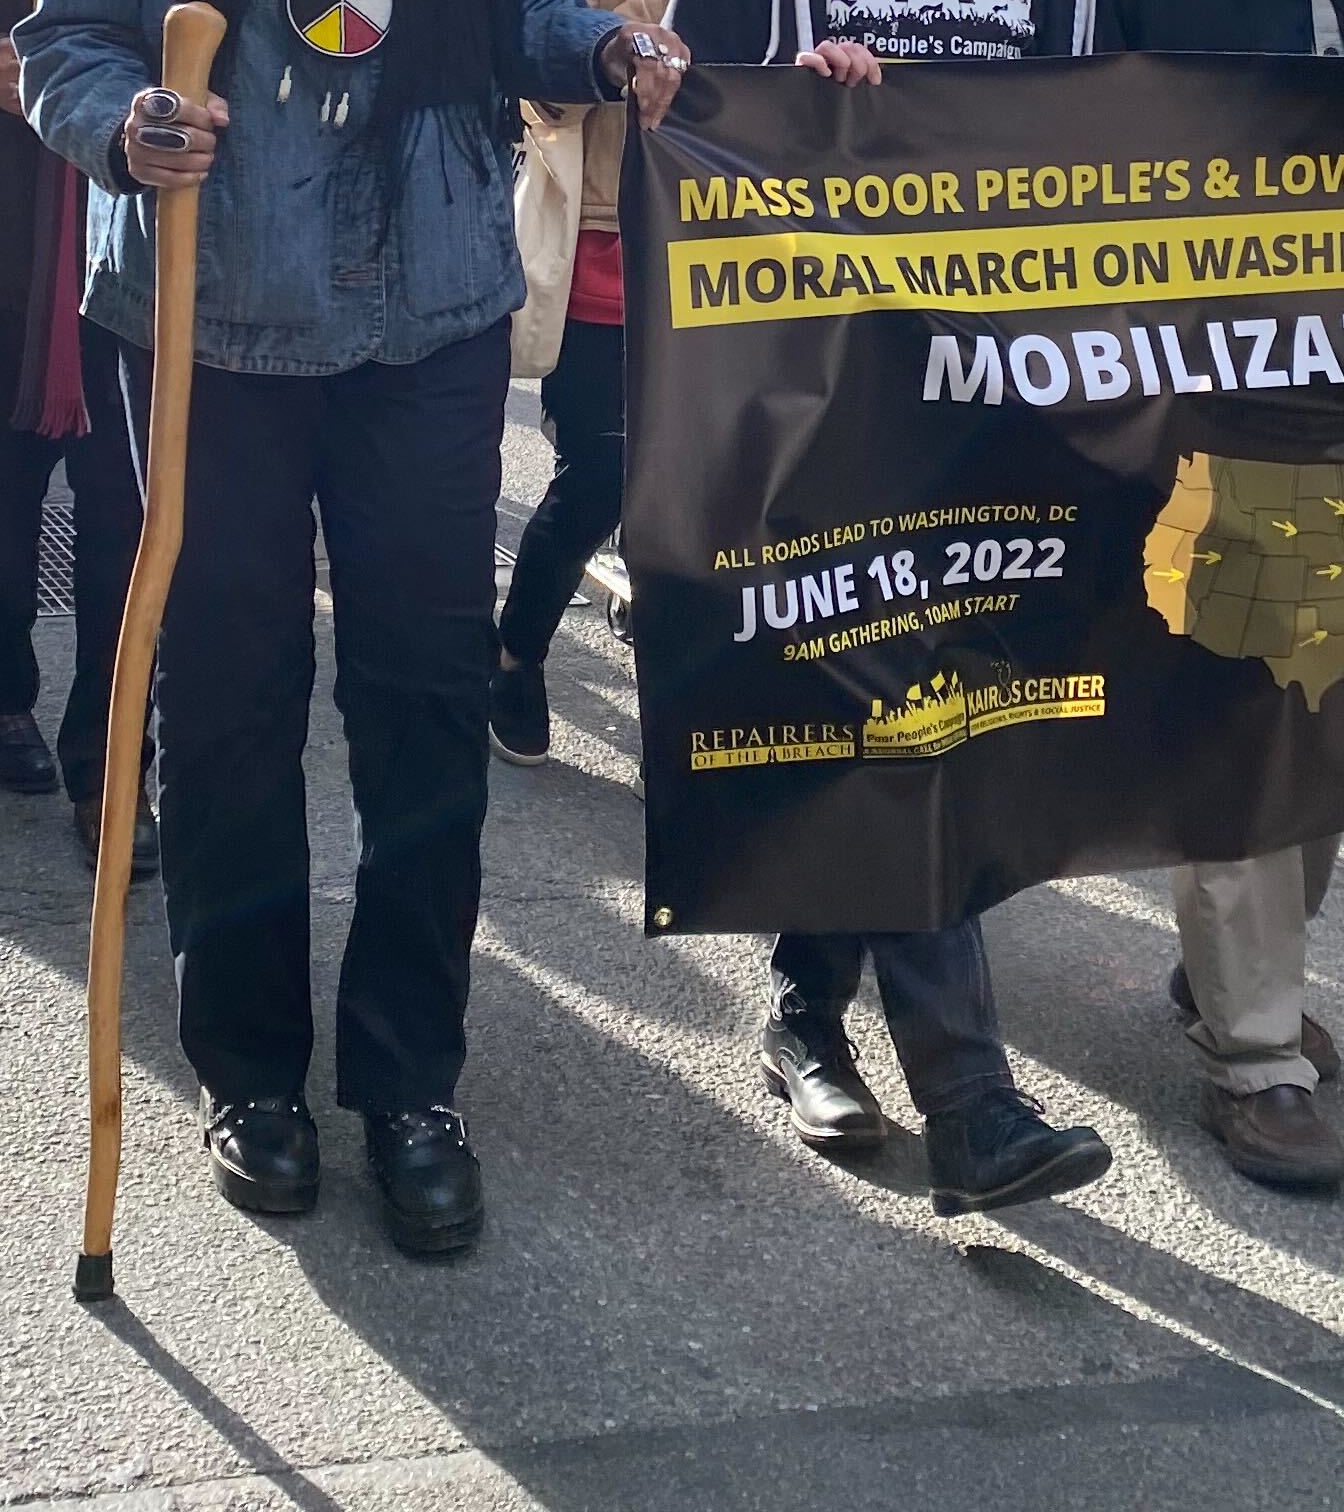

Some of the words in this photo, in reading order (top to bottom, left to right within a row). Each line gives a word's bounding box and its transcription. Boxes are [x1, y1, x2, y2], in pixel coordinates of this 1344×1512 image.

[863, 32, 944, 57] People's
[950, 35, 1022, 60] Campaign
[679, 176, 815, 222] MASS
[823, 172, 965, 219] POOR
[976, 159, 1191, 213] PEOPLE'S
[1202, 158, 1241, 200] &
[689, 253, 896, 310] MORAL
[896, 246, 1078, 297] MARCH
[1093, 240, 1169, 287] ON
[714, 548, 755, 571] ALL
[762, 533, 821, 564] ROADS
[823, 522, 866, 551] LEAD
[869, 517, 894, 538] TO
[897, 505, 1041, 532] WASHINGTON,
[1048, 505, 1079, 523] DC
[733, 563, 860, 643] JUNE
[866, 549, 930, 601] 18,
[942, 537, 1067, 587] 2022
[783, 637, 826, 662] 9AM
[828, 612, 925, 654] GATHERING,
[925, 599, 962, 629] 10AM
[964, 593, 1021, 616] START
[966, 678, 1022, 717] KAIROS
[1024, 675, 1105, 701] CENTER
[691, 724, 854, 752] REPAIRERS
[694, 754, 716, 768] OF
[726, 752, 762, 765] THE
[782, 744, 851, 760] BREACH
